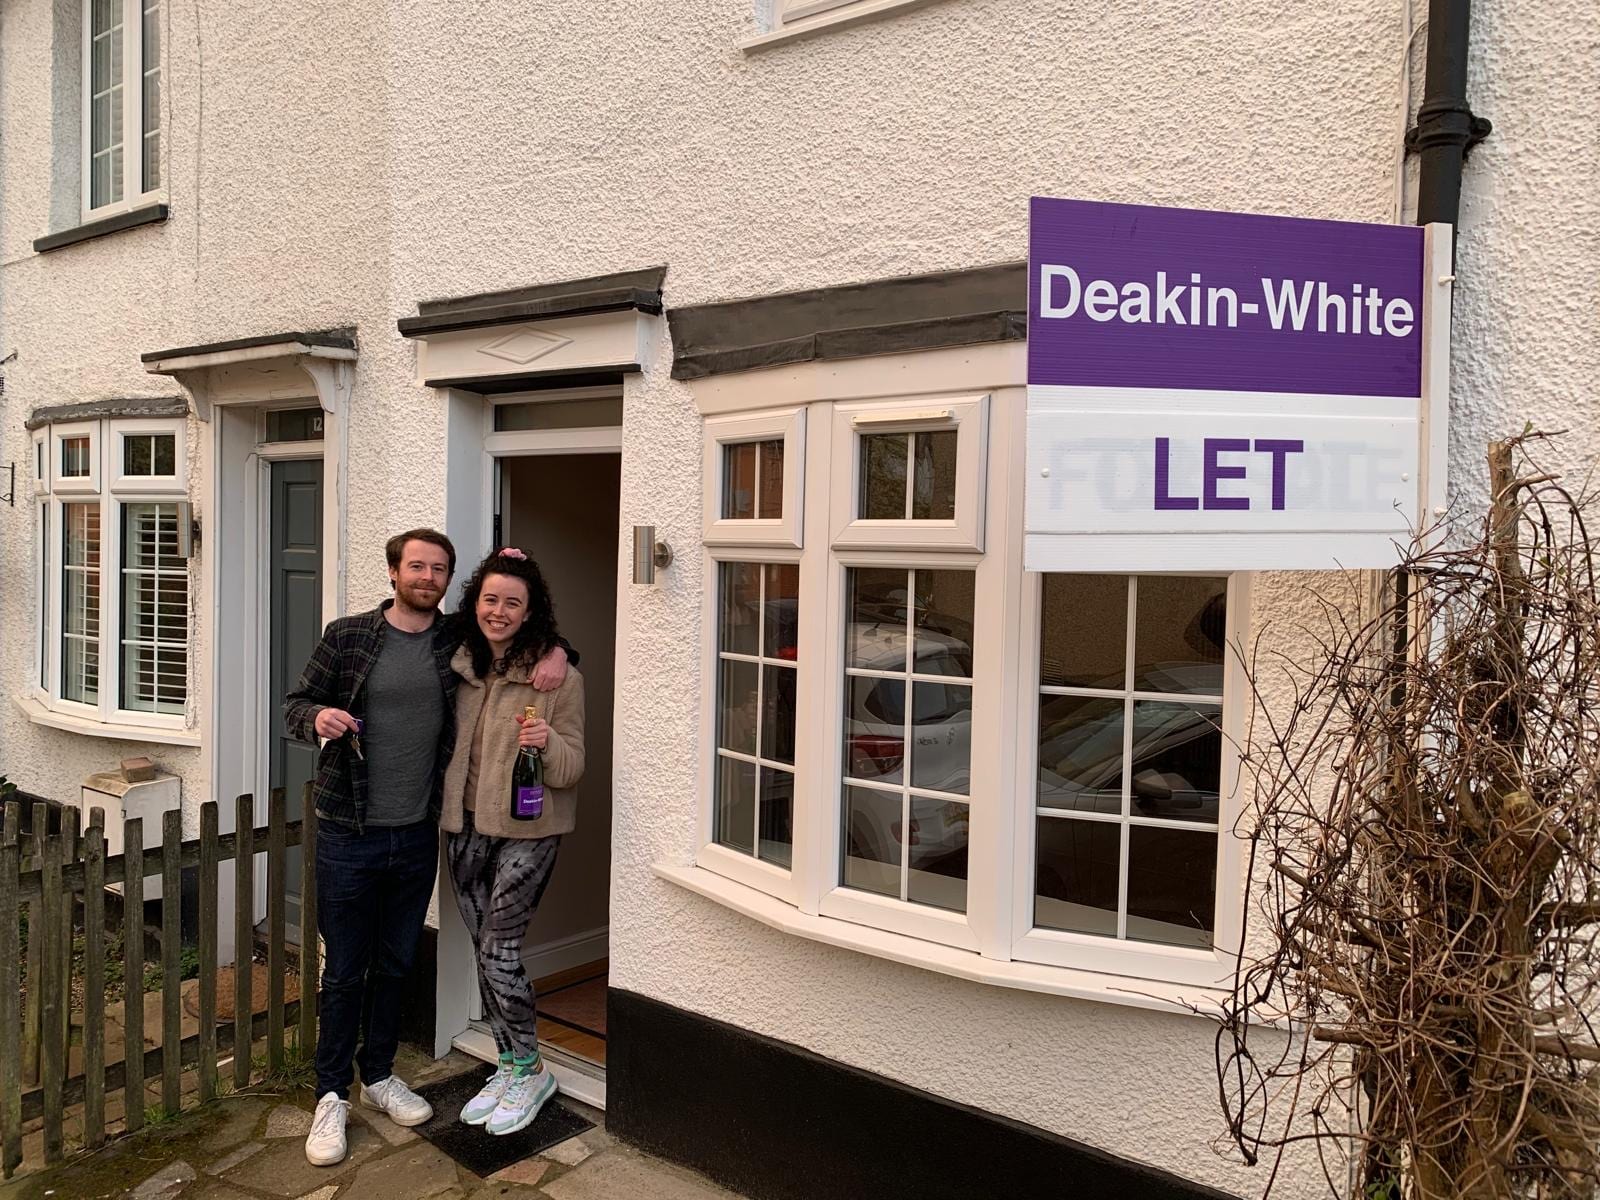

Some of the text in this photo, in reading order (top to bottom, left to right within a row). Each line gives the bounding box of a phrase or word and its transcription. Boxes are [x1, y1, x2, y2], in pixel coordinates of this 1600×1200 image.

[1040, 264, 1415, 337] Deakin-White
[313, 416, 323, 432] 12
[1154, 437, 1304, 511] LET
